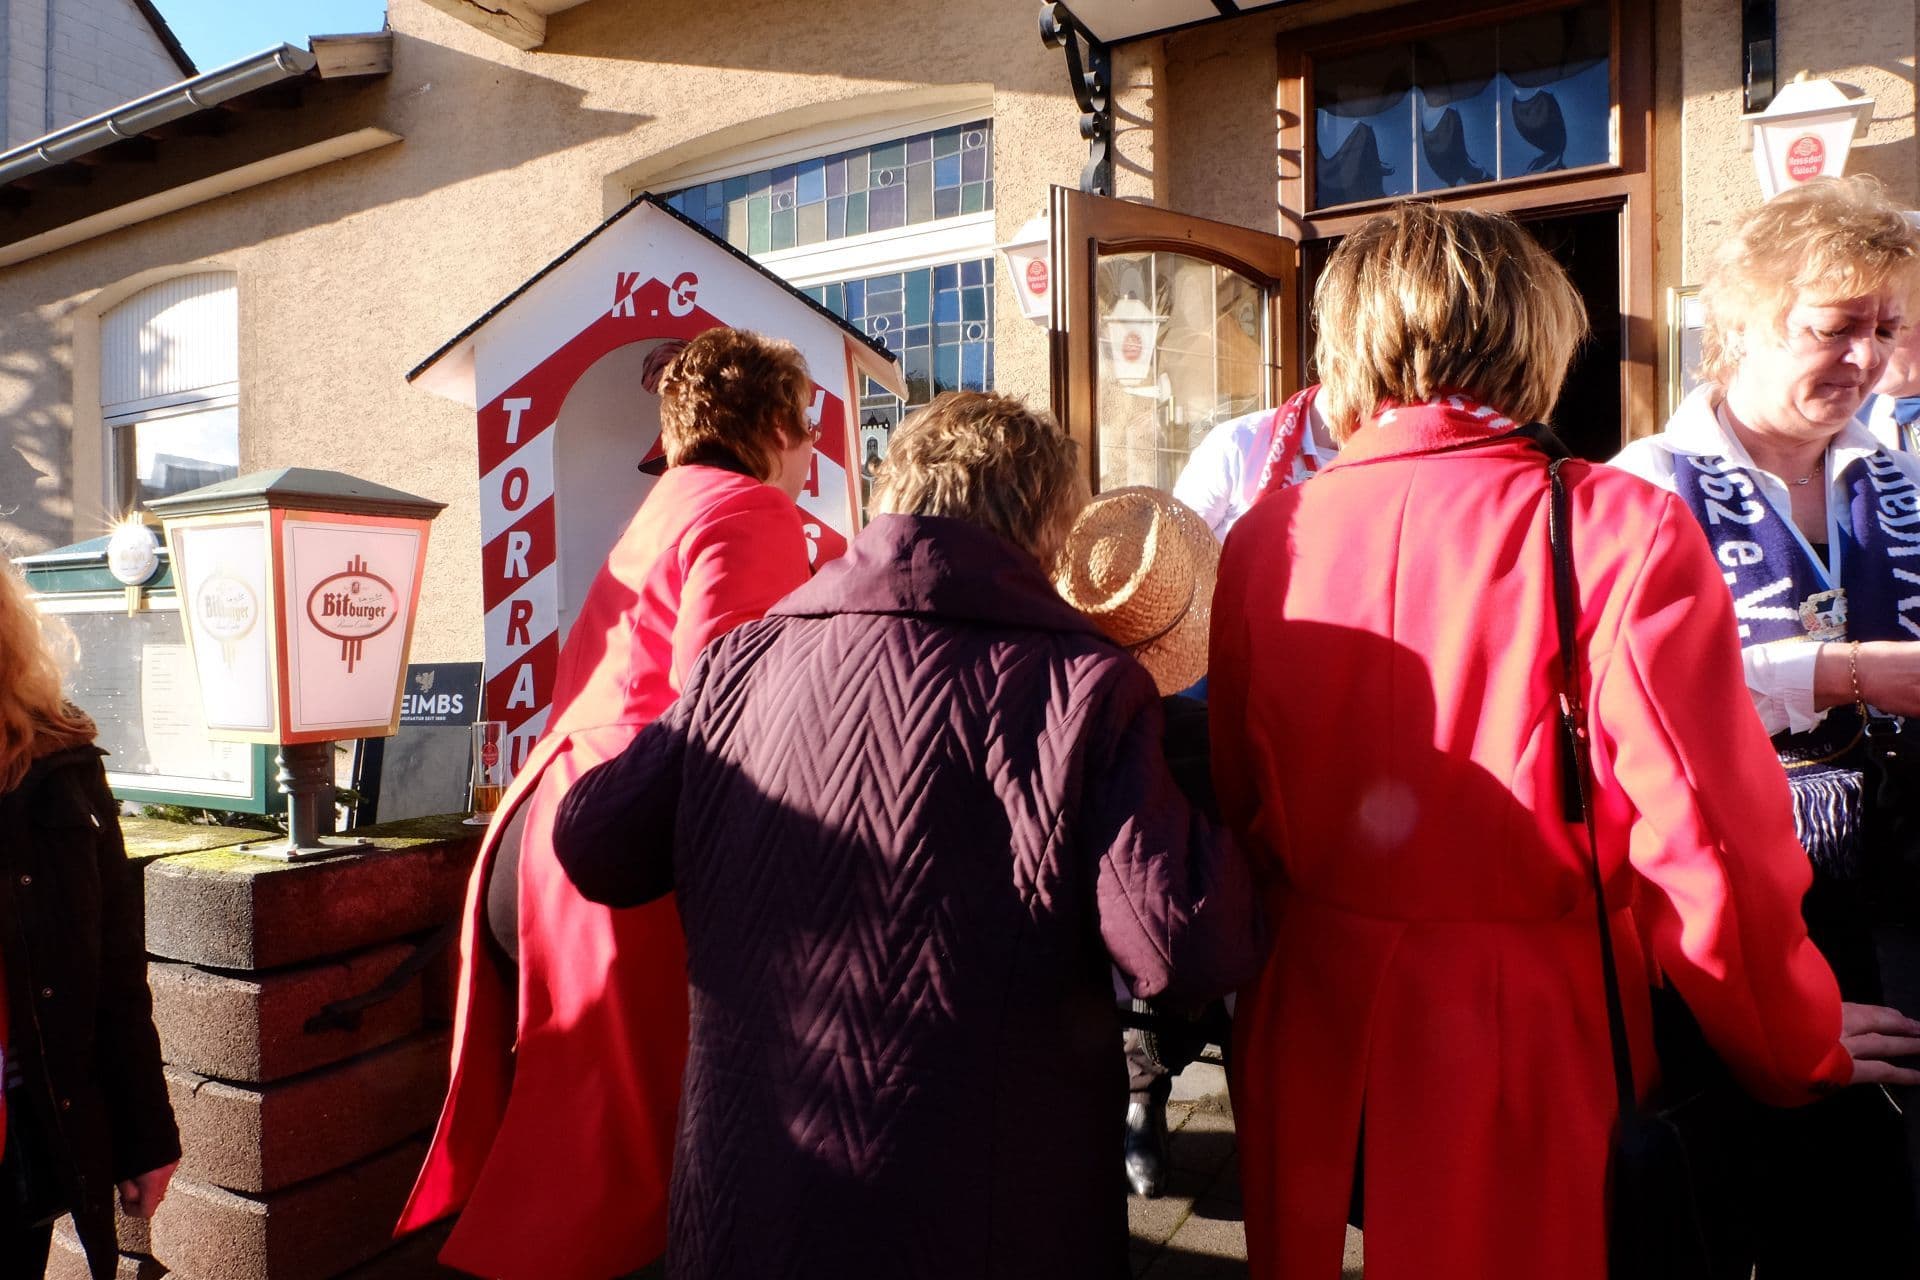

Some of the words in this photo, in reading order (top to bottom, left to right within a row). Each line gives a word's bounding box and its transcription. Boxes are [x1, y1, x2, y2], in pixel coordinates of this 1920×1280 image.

[1687, 454, 1765, 526] 962
[321, 592, 387, 621] Bitburger
[400, 693, 464, 715] EIMBS
